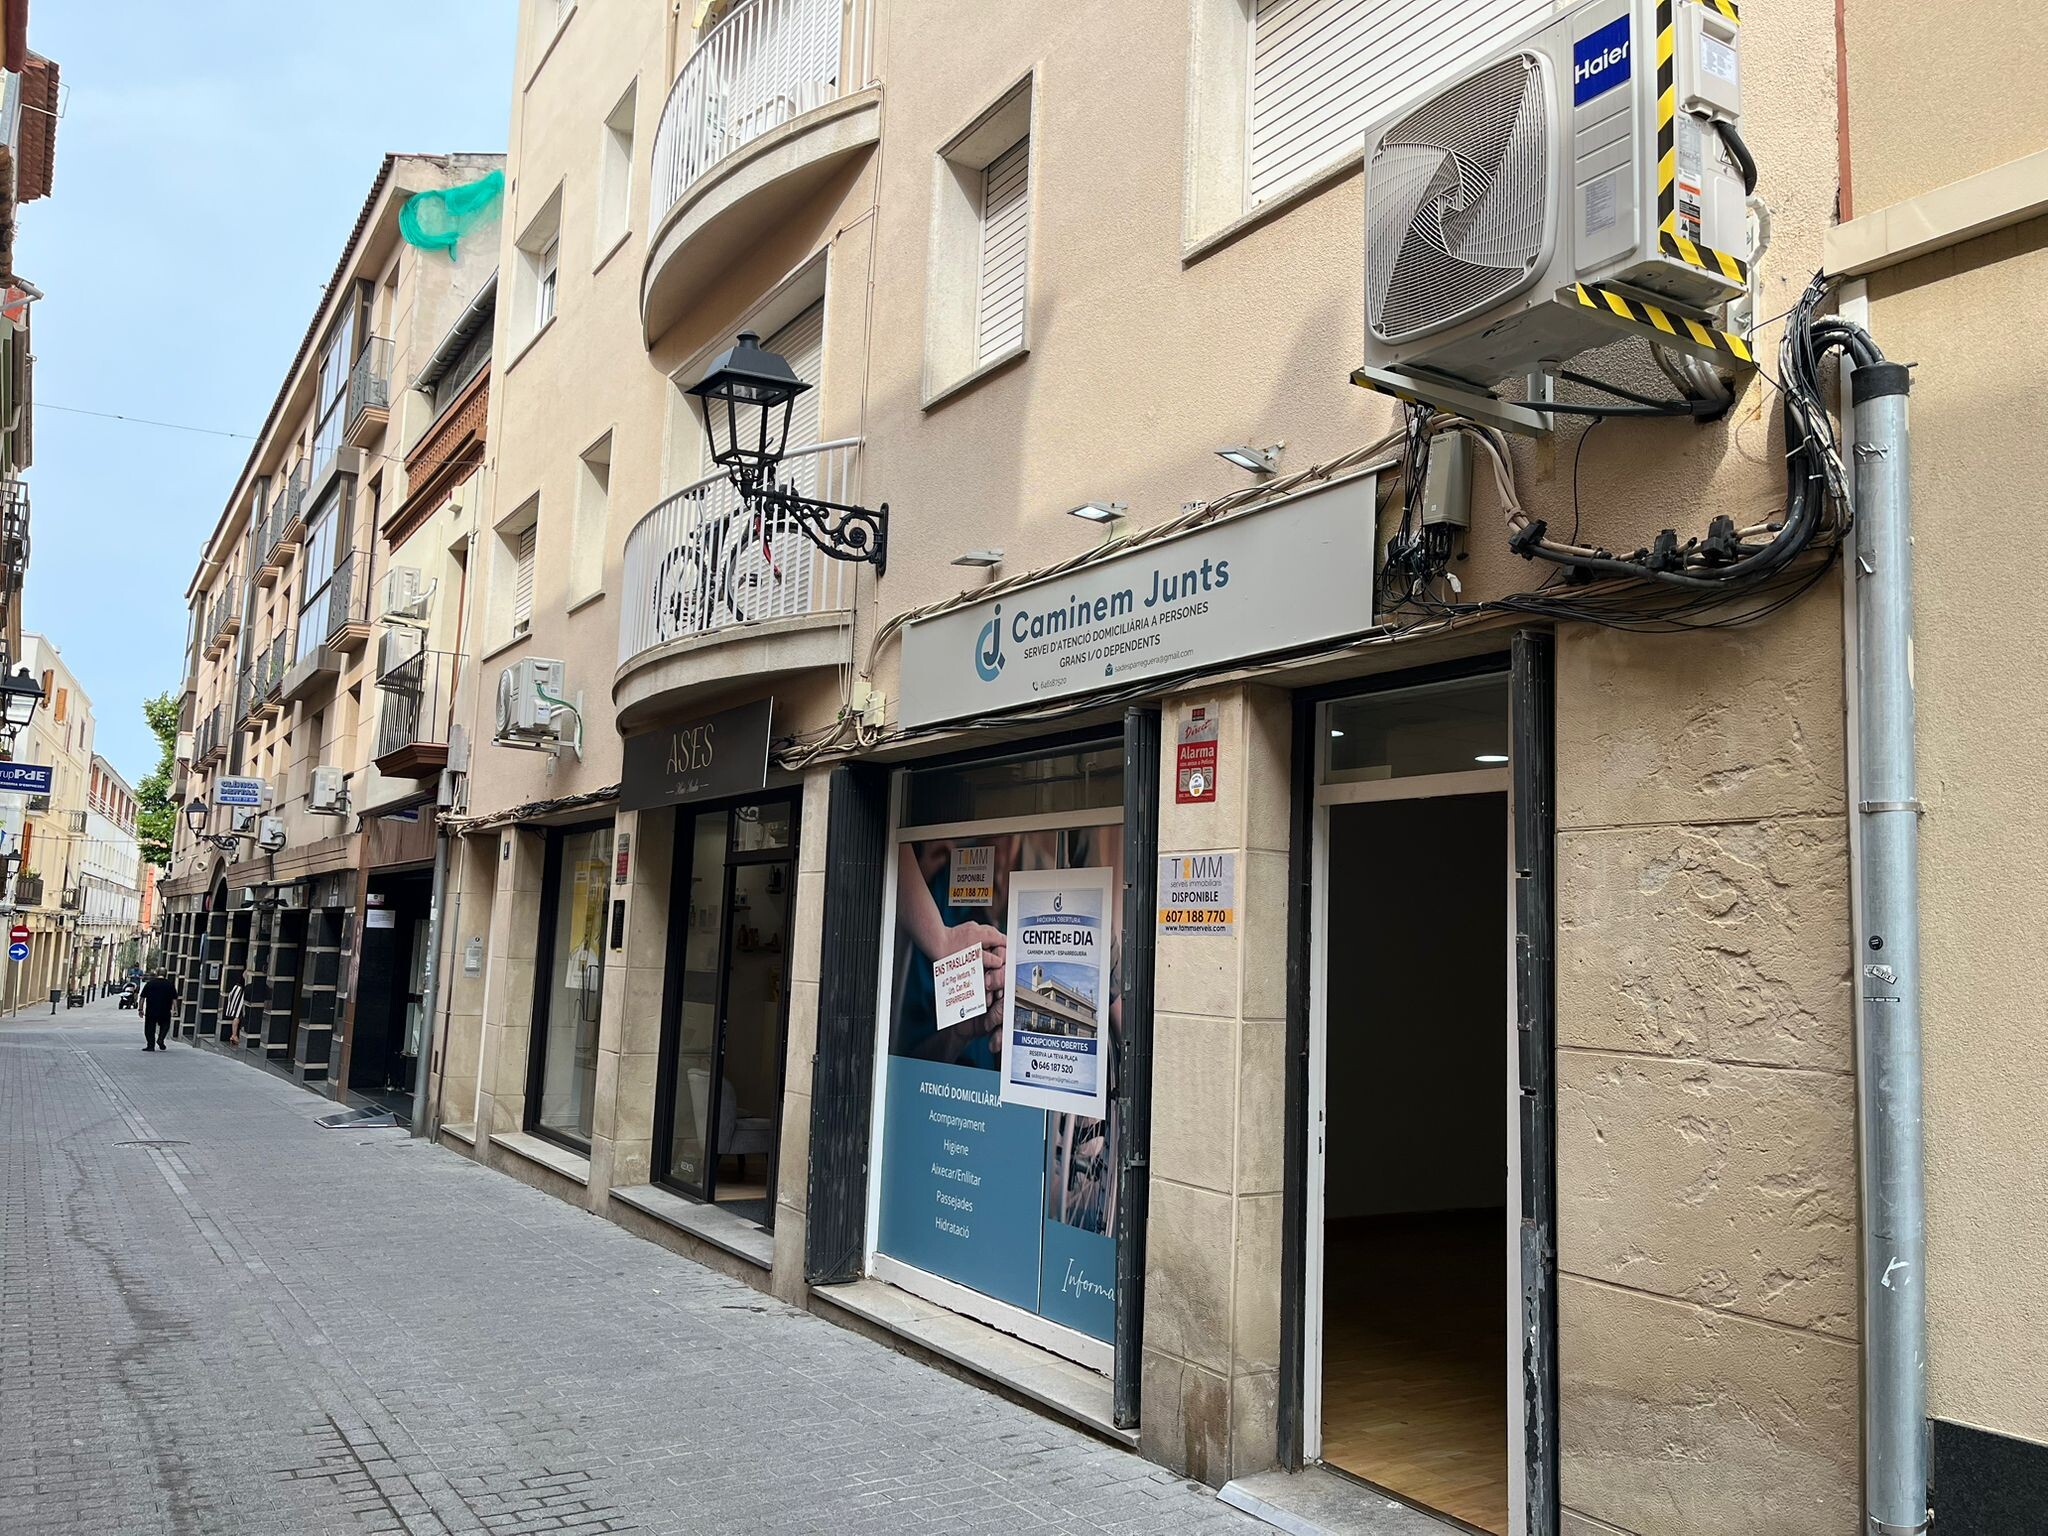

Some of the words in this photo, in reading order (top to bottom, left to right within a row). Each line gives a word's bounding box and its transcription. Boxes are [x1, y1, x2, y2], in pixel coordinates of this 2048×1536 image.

[1575, 41, 1629, 84] Haier
[1012, 589, 1133, 643] Caminem
[1144, 559, 1229, 608] Junts
[1024, 644, 1049, 659] SERVEI
[1050, 630, 1091, 653] D'ATENCIÓ
[1093, 615, 1149, 641] DOMICILIÀRIA
[1151, 615, 1158, 627] A
[1160, 601, 1209, 624] PERSONES
[1060, 653, 1086, 668] GRANS
[1088, 646, 1103, 661] I/O
[1104, 634, 1161, 658] DEPENDENTS
[667, 723, 714, 775] ASES
[1180, 746, 1215, 760] Alarma
[957, 873, 985, 882] DISPONIBLE
[952, 887, 964, 897] 607
[965, 887, 976, 897] 188
[977, 887, 989, 897] 770
[1171, 891, 1219, 903] DISPONIBLE
[1165, 910, 1183, 923] 607
[1186, 910, 1204, 923] 188
[1207, 910, 1226, 923] 770
[1022, 930, 1061, 945] CENTRE
[1062, 933, 1072, 943] DE
[1073, 931, 1094, 946] DIA
[935, 963, 945, 977] ENS
[1021, 1036, 1060, 1048] INSCRIPCIONS
[1060, 1040, 1088, 1052] OBERTES
[1029, 1050, 1047, 1058] RESERVA
[1039, 1061, 1050, 1071] 646
[1051, 1063, 1060, 1072] 187
[1061, 1065, 1073, 1074] 520
[920, 1082, 950, 1098] ATENCIÓ
[951, 1087, 1003, 1108] DOMICILIÀRIA
[929, 1109, 986, 1132] Acompanyament
[943, 1139, 969, 1155] Higiene
[931, 1162, 981, 1186] Aixecar/Enllitar
[936, 1190, 973, 1212] Passejades
[935, 1216, 970, 1239] Hidratació
[1061, 1257, 1116, 1301] Informa
